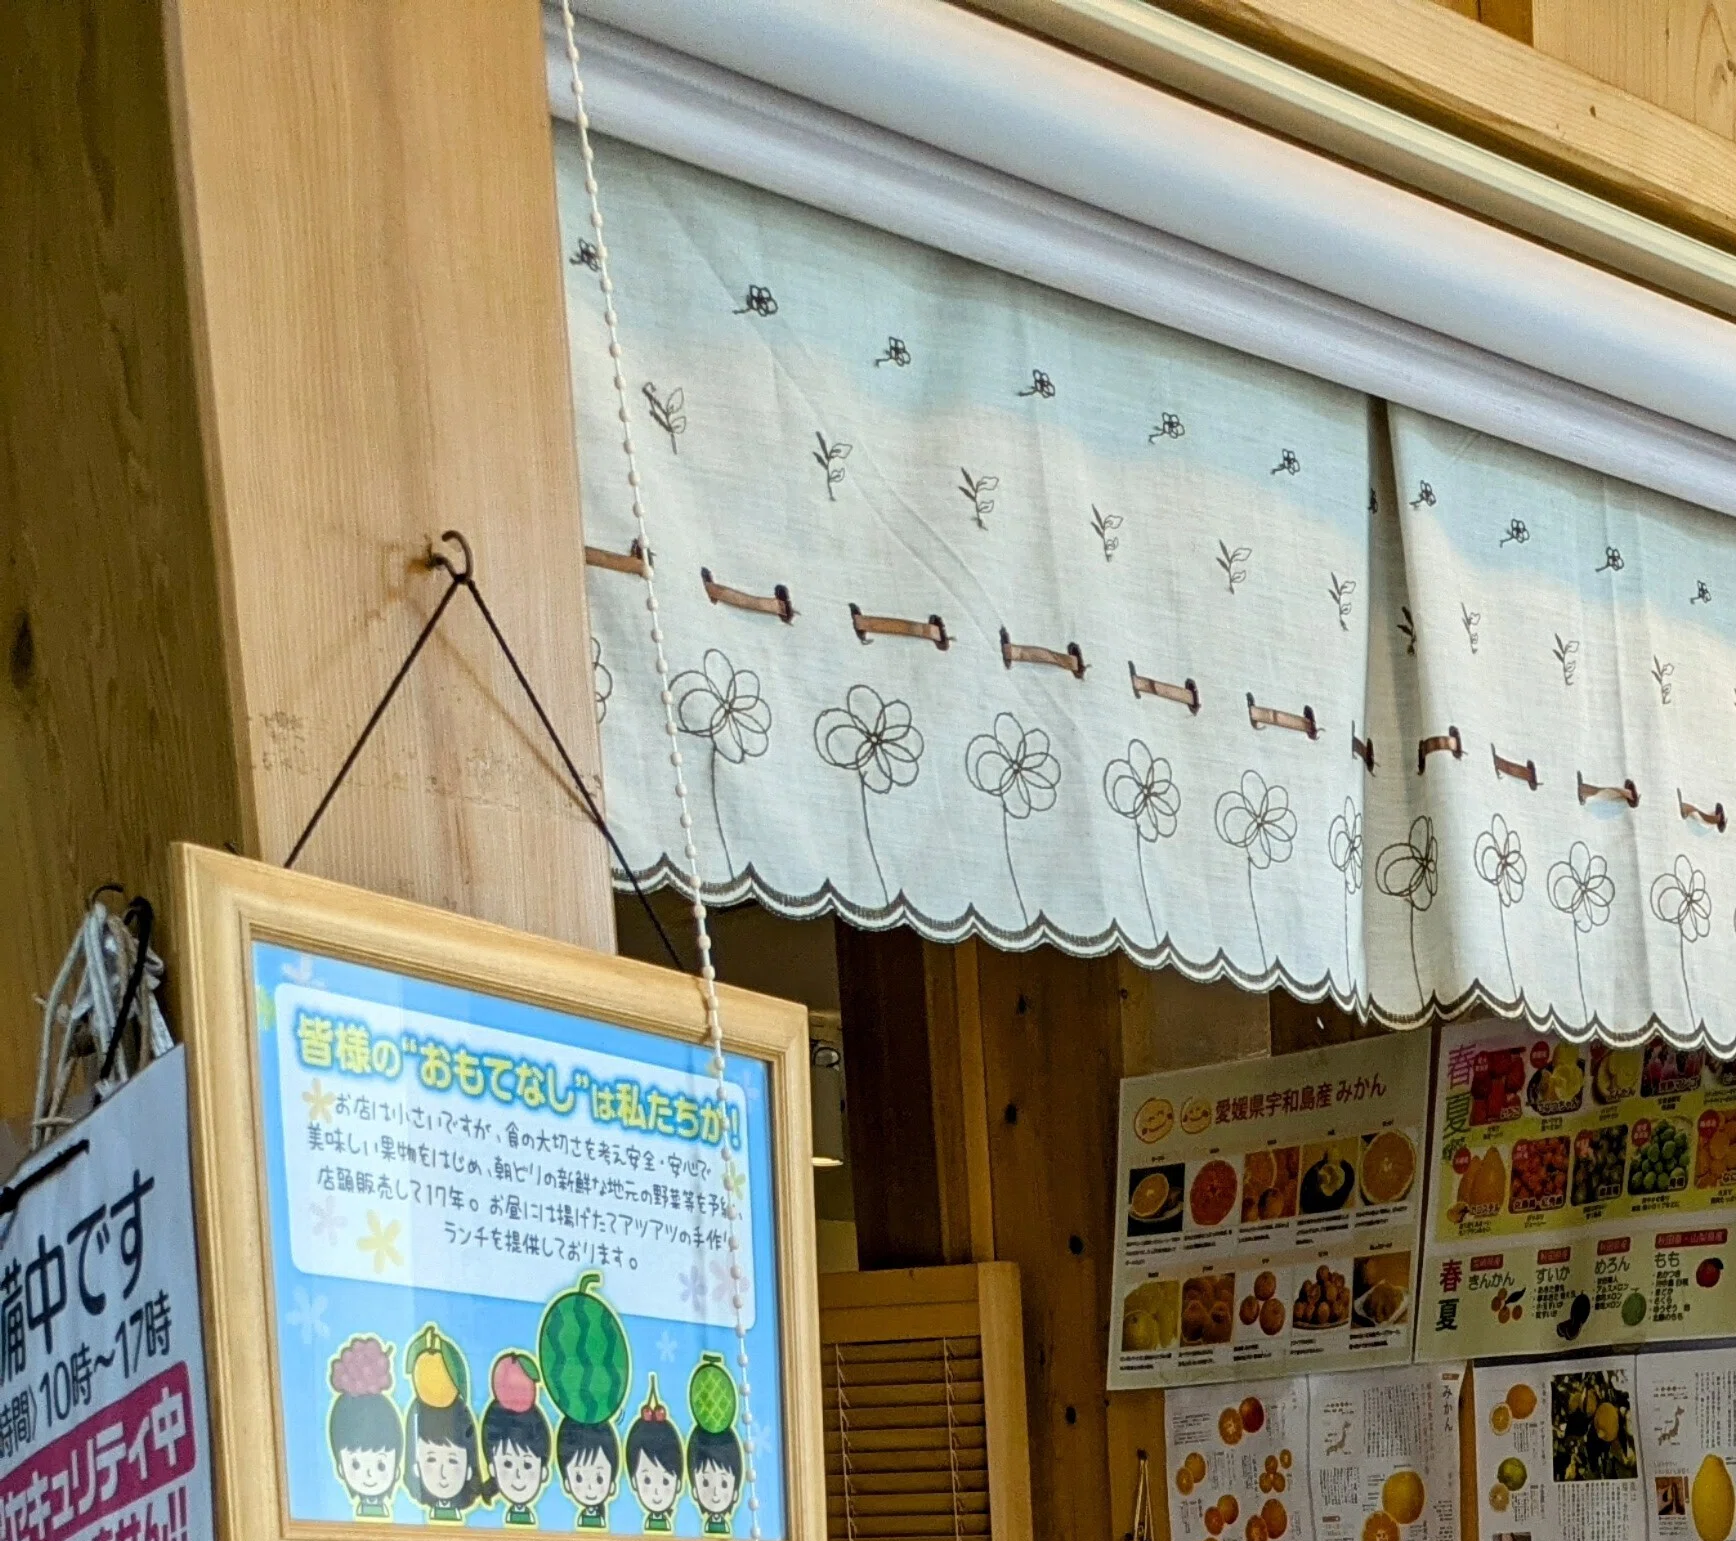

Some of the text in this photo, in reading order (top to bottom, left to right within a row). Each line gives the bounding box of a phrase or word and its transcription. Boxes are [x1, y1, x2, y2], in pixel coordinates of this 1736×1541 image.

[1215, 1073, 1387, 1125] 愛媛県宇和島産 みかん
[1594, 1256, 1630, 1275] めろん
[1654, 1251, 1681, 1268] もも
[1468, 1270, 1515, 1291] きんかん
[1536, 1266, 1571, 1284] すいか
[1442, 1384, 1453, 1432] みかん
